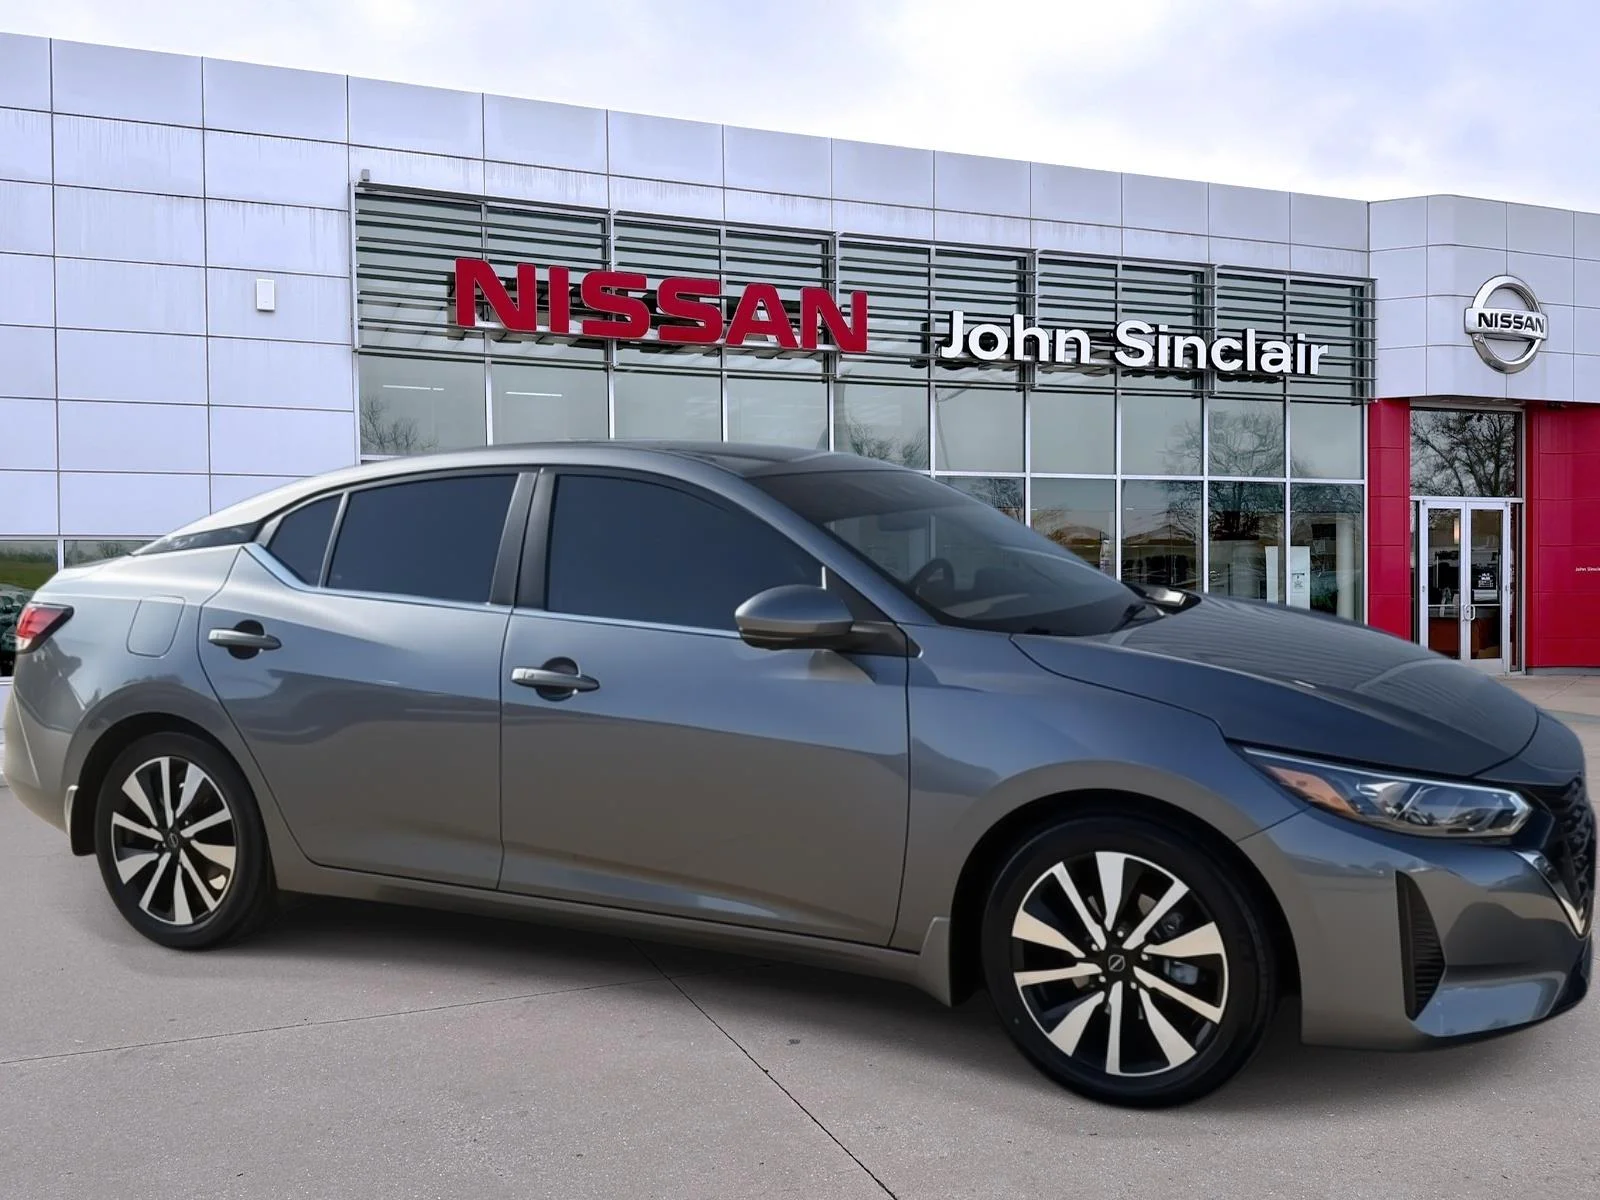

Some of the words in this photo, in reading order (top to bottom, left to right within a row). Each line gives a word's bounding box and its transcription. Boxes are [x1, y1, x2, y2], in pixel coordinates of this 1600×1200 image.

[454, 257, 868, 353] NISSAN
[1477, 312, 1545, 333] NISSAN
[940, 310, 1091, 363] John
[1113, 319, 1329, 375] Sinclair
